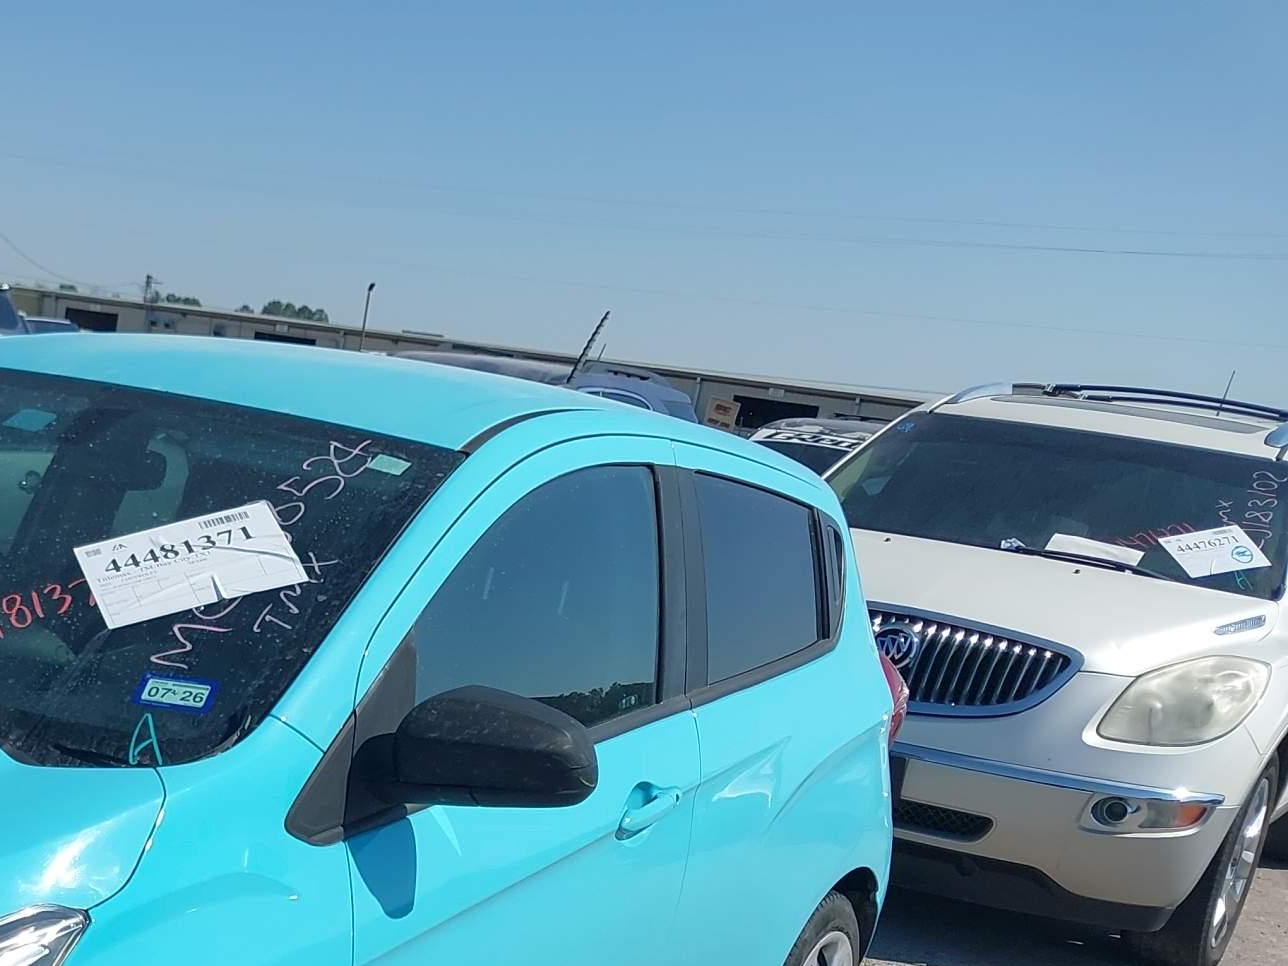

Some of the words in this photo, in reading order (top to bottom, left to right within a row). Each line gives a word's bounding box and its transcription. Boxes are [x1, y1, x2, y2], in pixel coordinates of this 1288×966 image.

[104, 525, 256, 574] 44481371
[1175, 535, 1241, 553] 44476271
[147, 686, 173, 699] 07
[179, 690, 205, 704] 26
[129, 713, 163, 765] A
